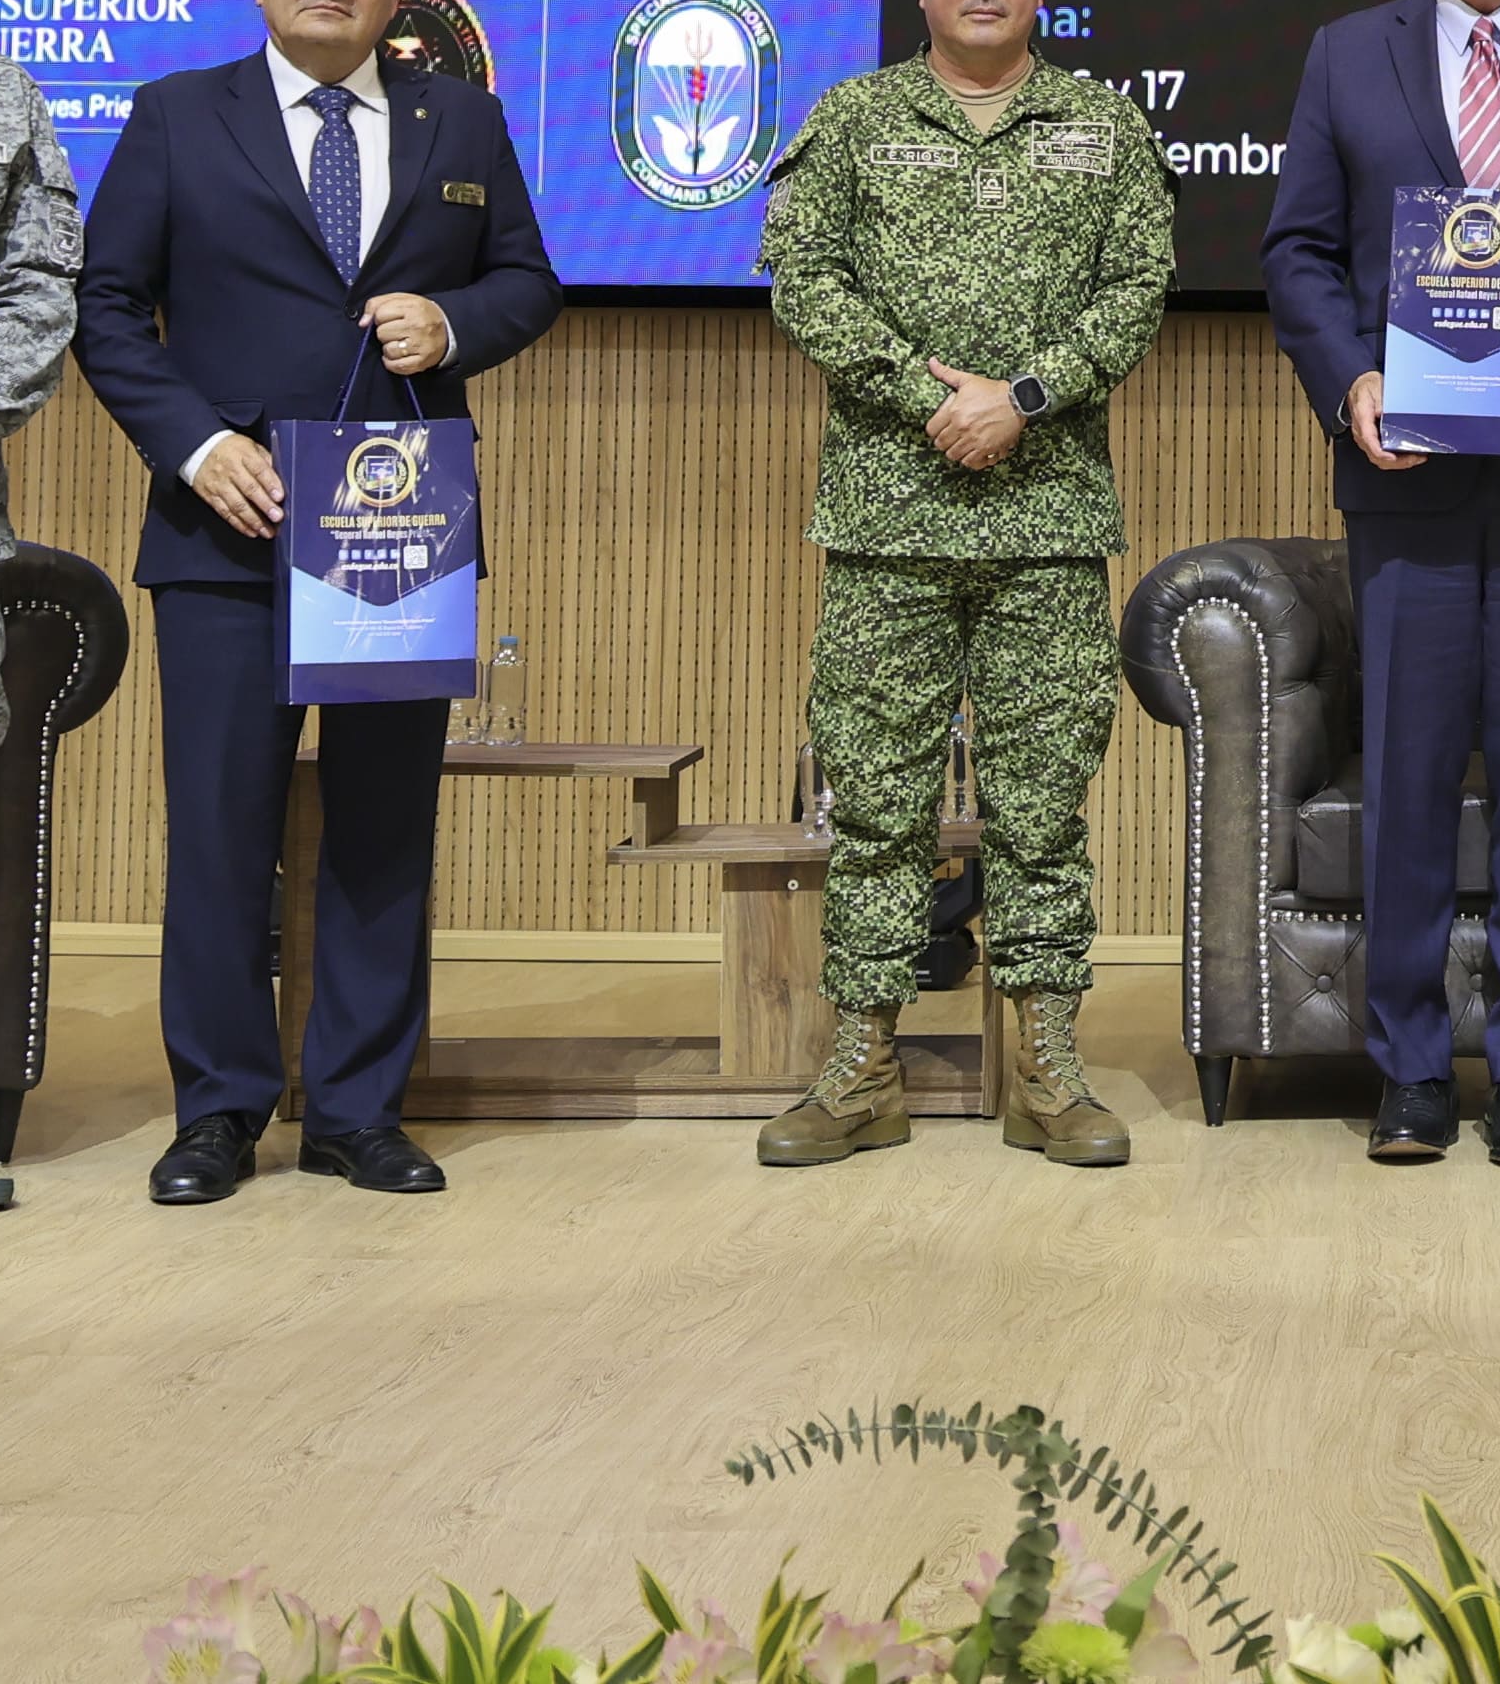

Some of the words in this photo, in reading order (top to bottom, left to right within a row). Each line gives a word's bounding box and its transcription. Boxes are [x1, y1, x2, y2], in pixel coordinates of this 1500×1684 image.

[1141, 69, 1186, 111] 17
[1046, 156, 1099, 169] ARMADA
[631, 158, 707, 204] COMMAND
[710, 158, 760, 203] SOUTH
[1416, 275, 1449, 287] ESCUELA
[1450, 276, 1490, 289] SUPERIOR
[320, 515, 356, 528] ESCUELA
[412, 513, 447, 527] GUERRA
